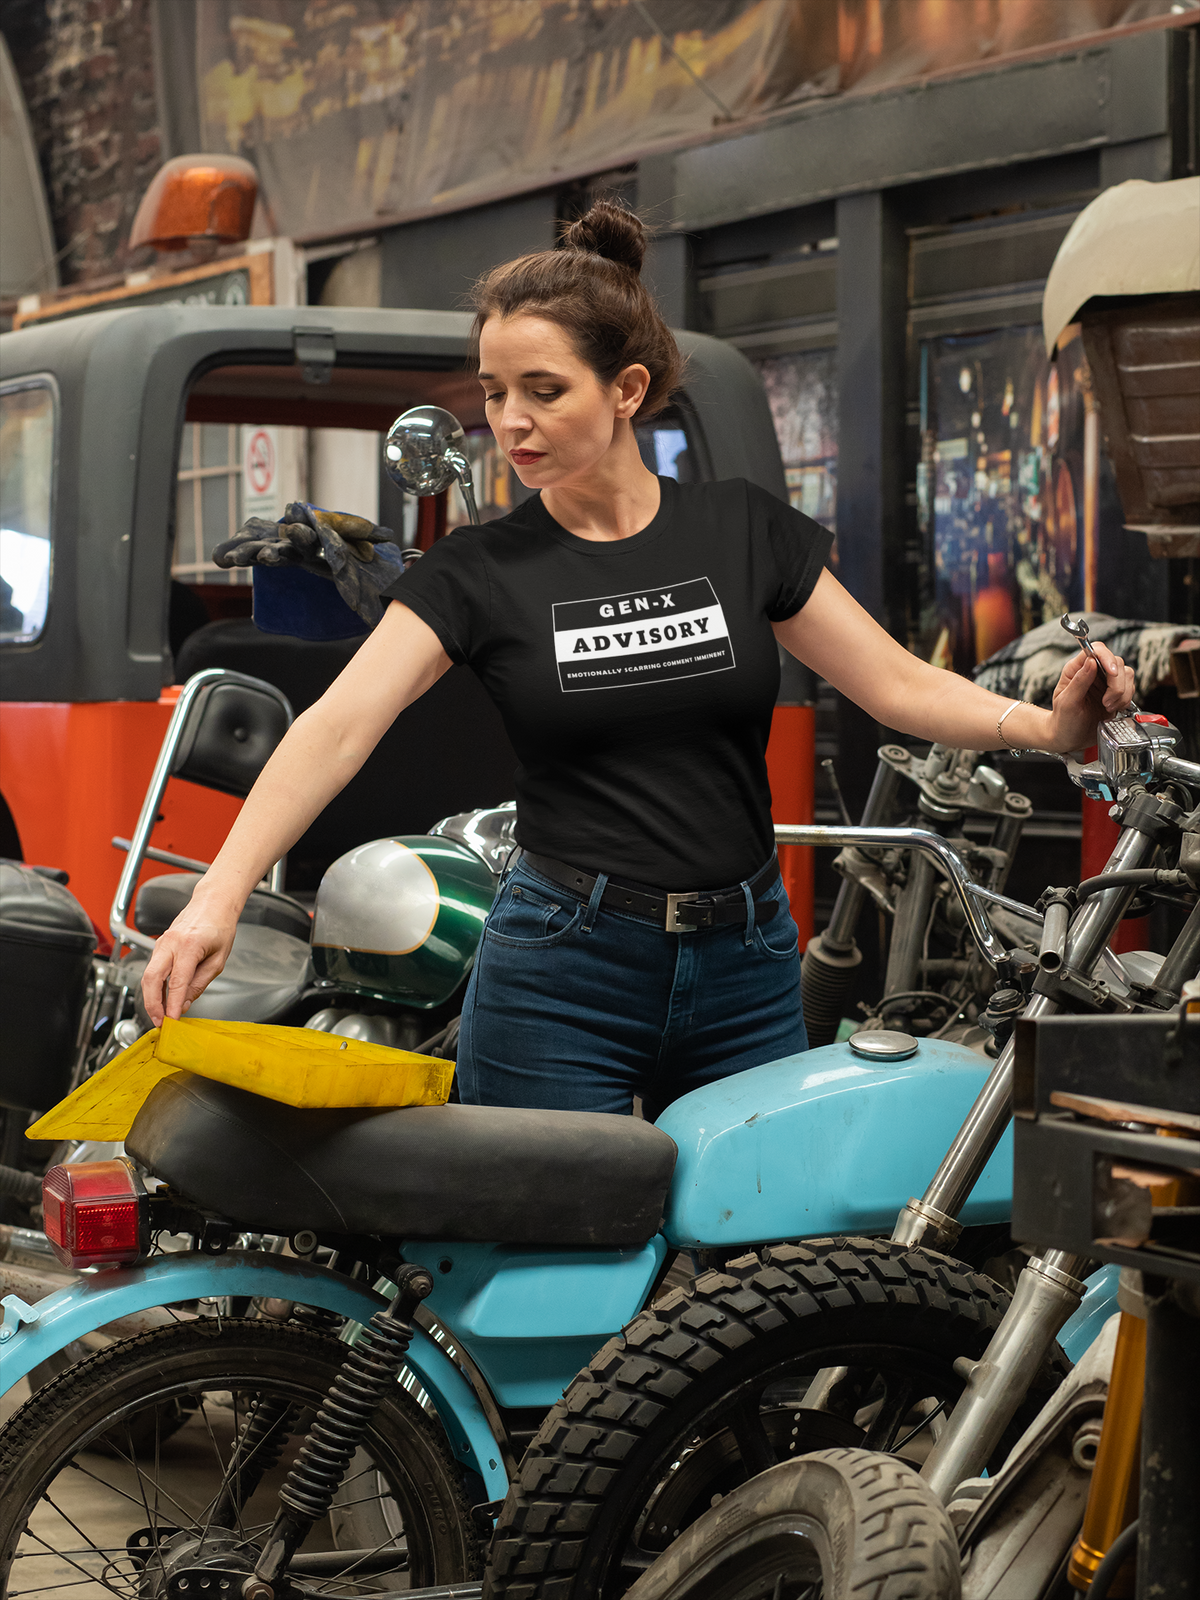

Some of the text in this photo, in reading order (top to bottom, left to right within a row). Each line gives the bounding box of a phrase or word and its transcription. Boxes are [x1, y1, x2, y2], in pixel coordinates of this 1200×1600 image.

[599, 593, 676, 618] GEN-X
[572, 617, 710, 654] ADVISORY
[567, 650, 726, 679] EMOTIONALLY SCARRING COMMENT IMMINENT
[423, 1481, 447, 1536] DURO
